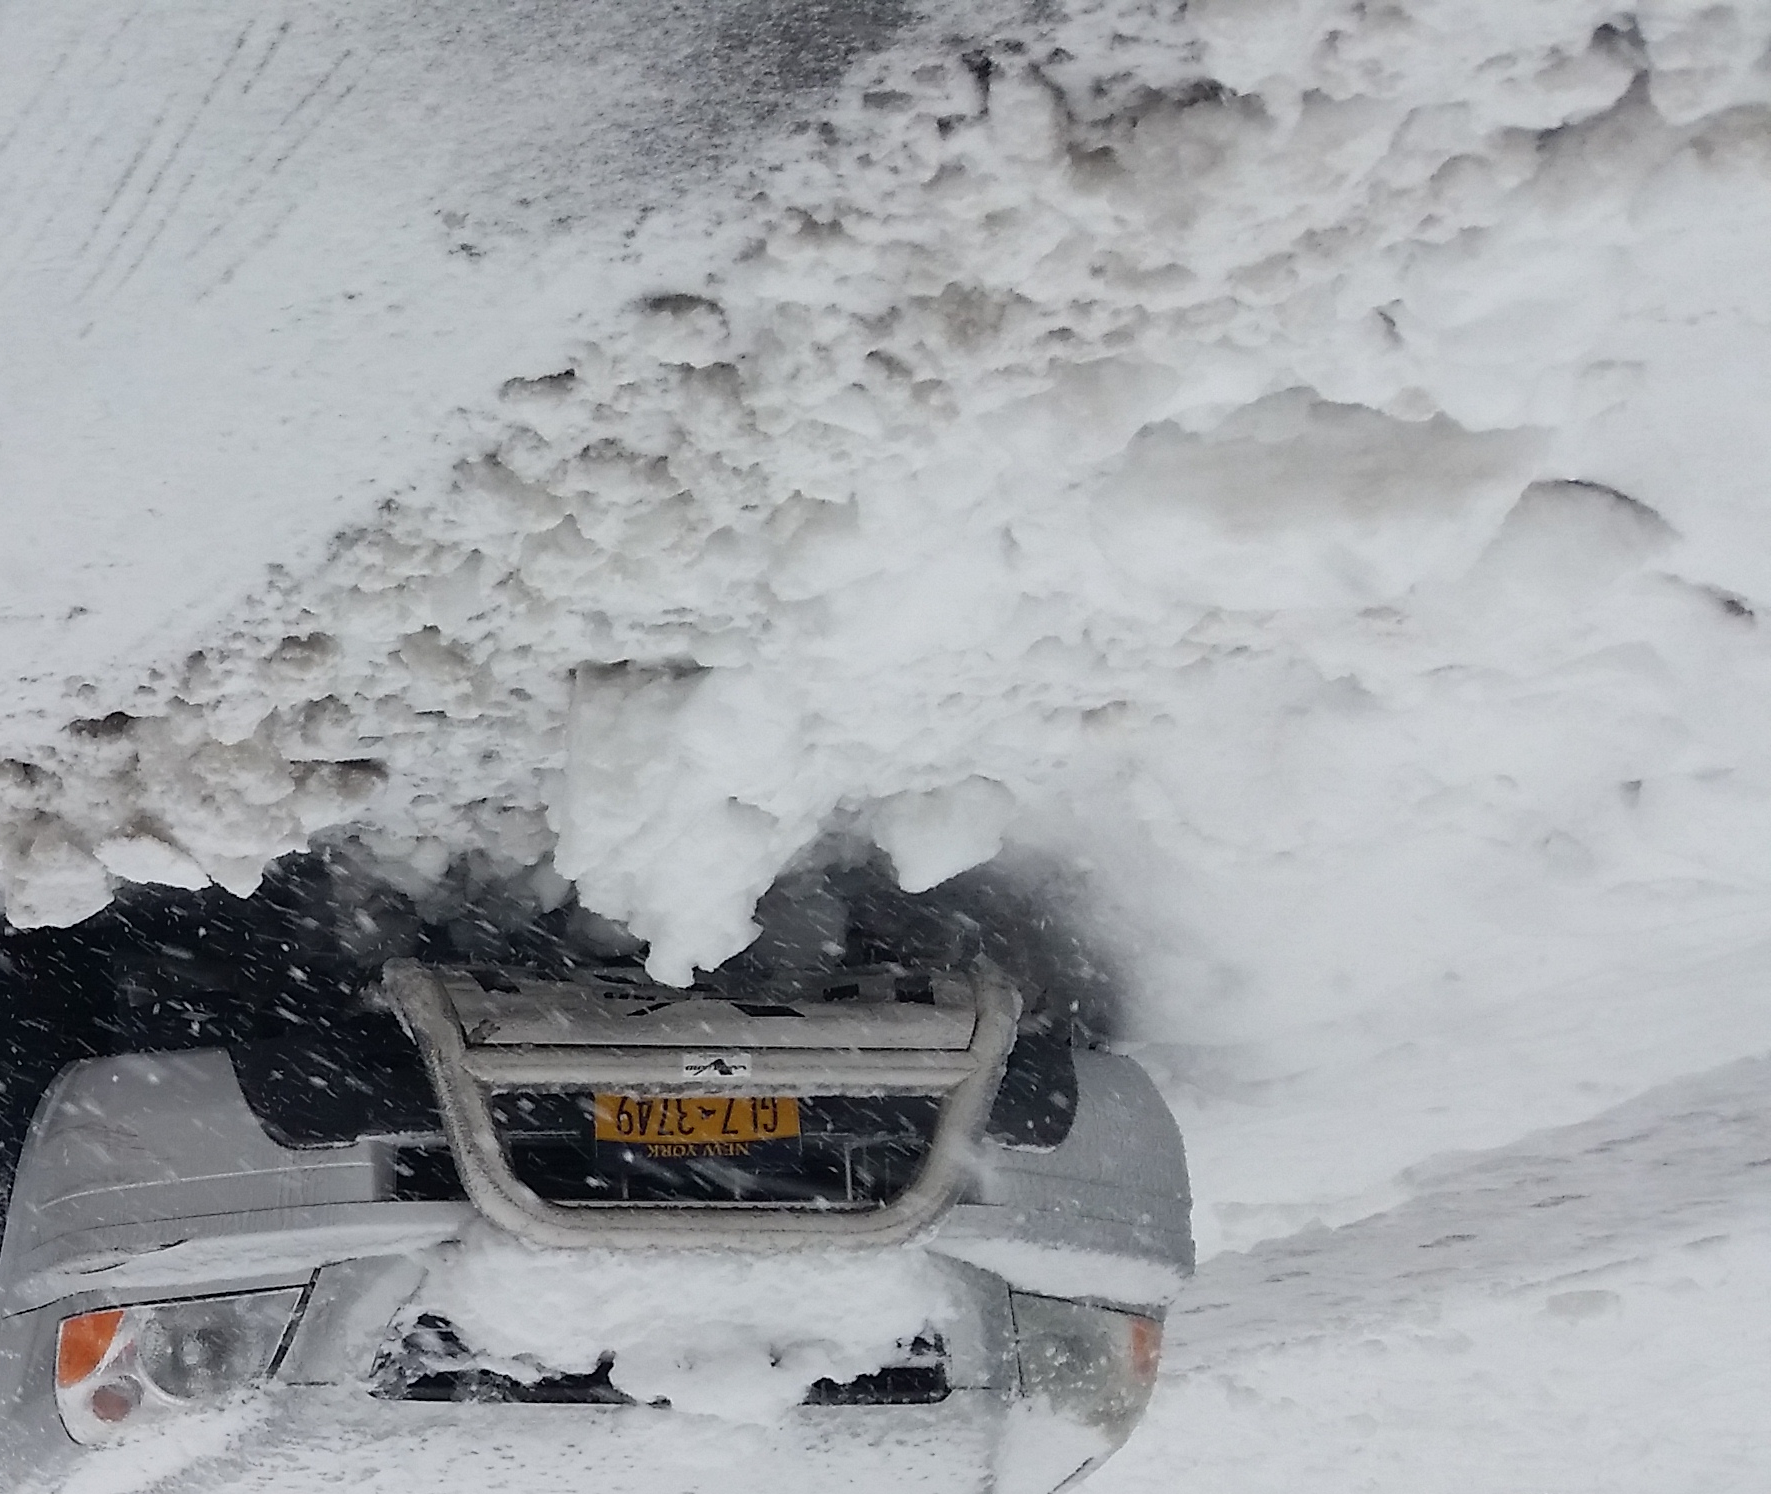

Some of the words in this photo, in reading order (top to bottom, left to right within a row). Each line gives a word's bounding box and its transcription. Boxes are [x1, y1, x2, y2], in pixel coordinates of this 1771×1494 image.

[616, 1096, 695, 1136] 3749
[645, 1143, 696, 1158] YORK
[702, 1142, 750, 1157] NEW
